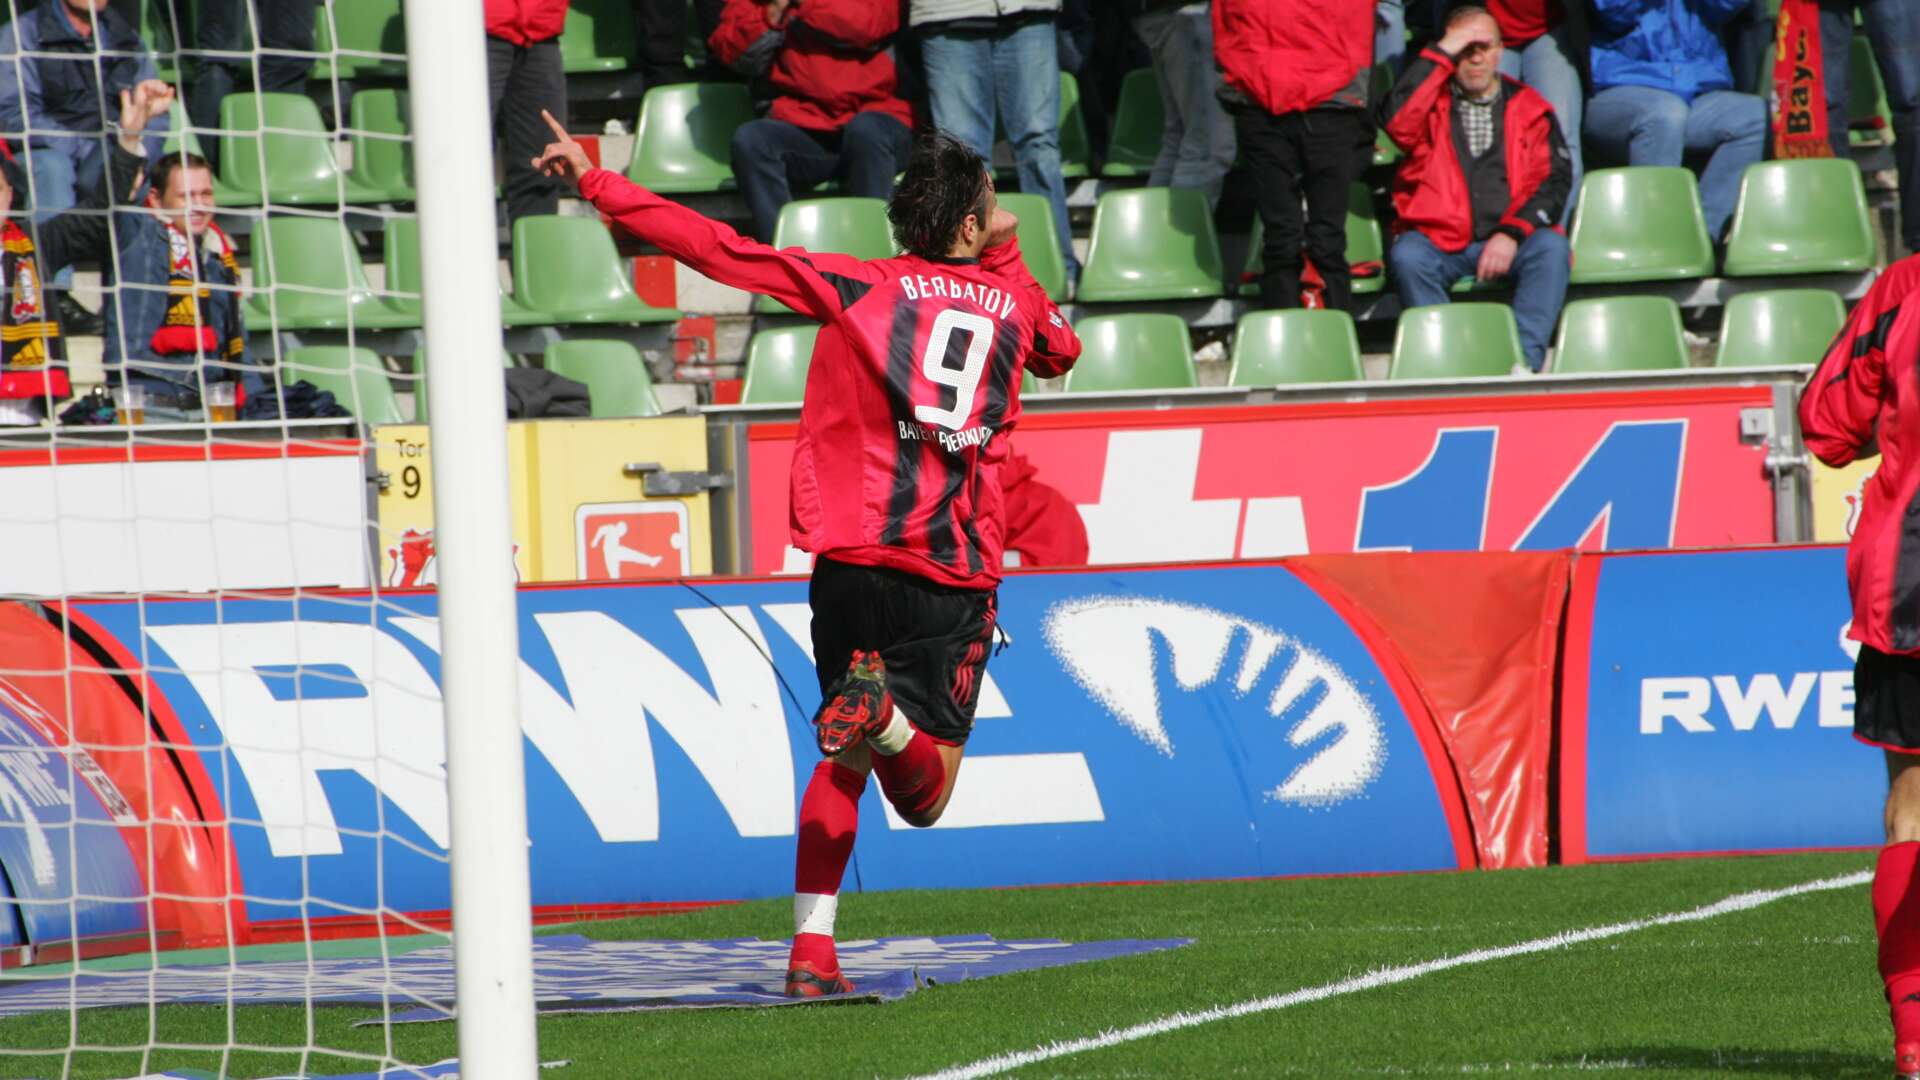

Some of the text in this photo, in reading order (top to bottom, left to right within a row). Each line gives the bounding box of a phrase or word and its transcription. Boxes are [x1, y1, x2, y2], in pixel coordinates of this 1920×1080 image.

[900, 274, 1016, 320] BERBATOV
[914, 308, 994, 431] 9
[394, 439, 424, 457] Tor
[402, 465, 421, 499] 9
[1640, 669, 1855, 734] RWE
